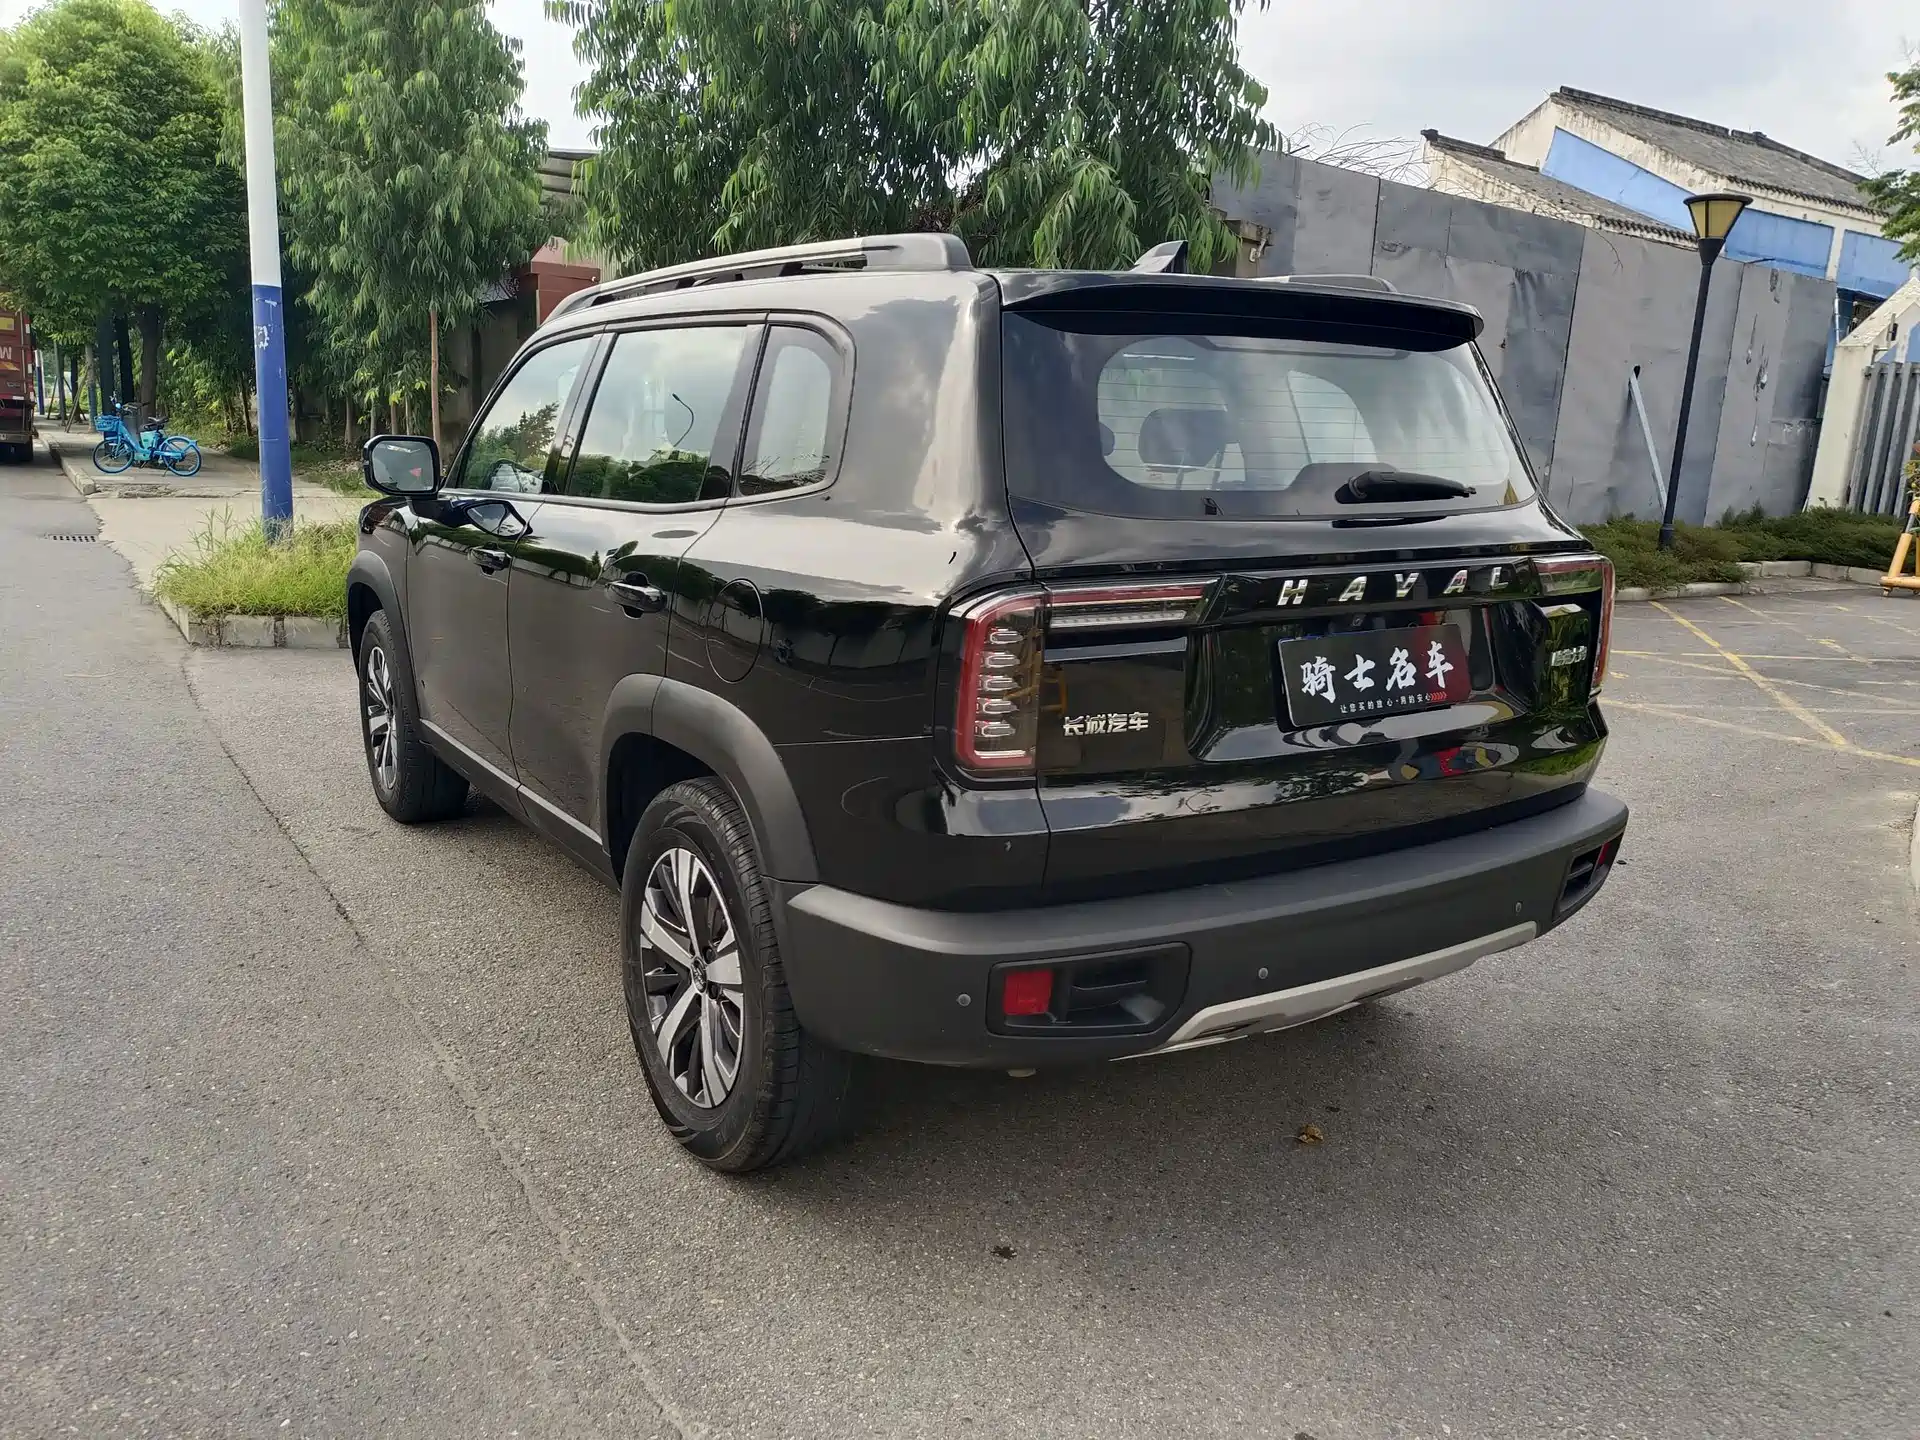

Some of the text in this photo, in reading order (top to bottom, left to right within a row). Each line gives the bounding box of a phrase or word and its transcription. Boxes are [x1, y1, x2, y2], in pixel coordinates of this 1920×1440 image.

[1278, 567, 1509, 606] HAVAL
[1300, 641, 1454, 704] 骑士名车
[1063, 712, 1149, 736] 长城汽车
